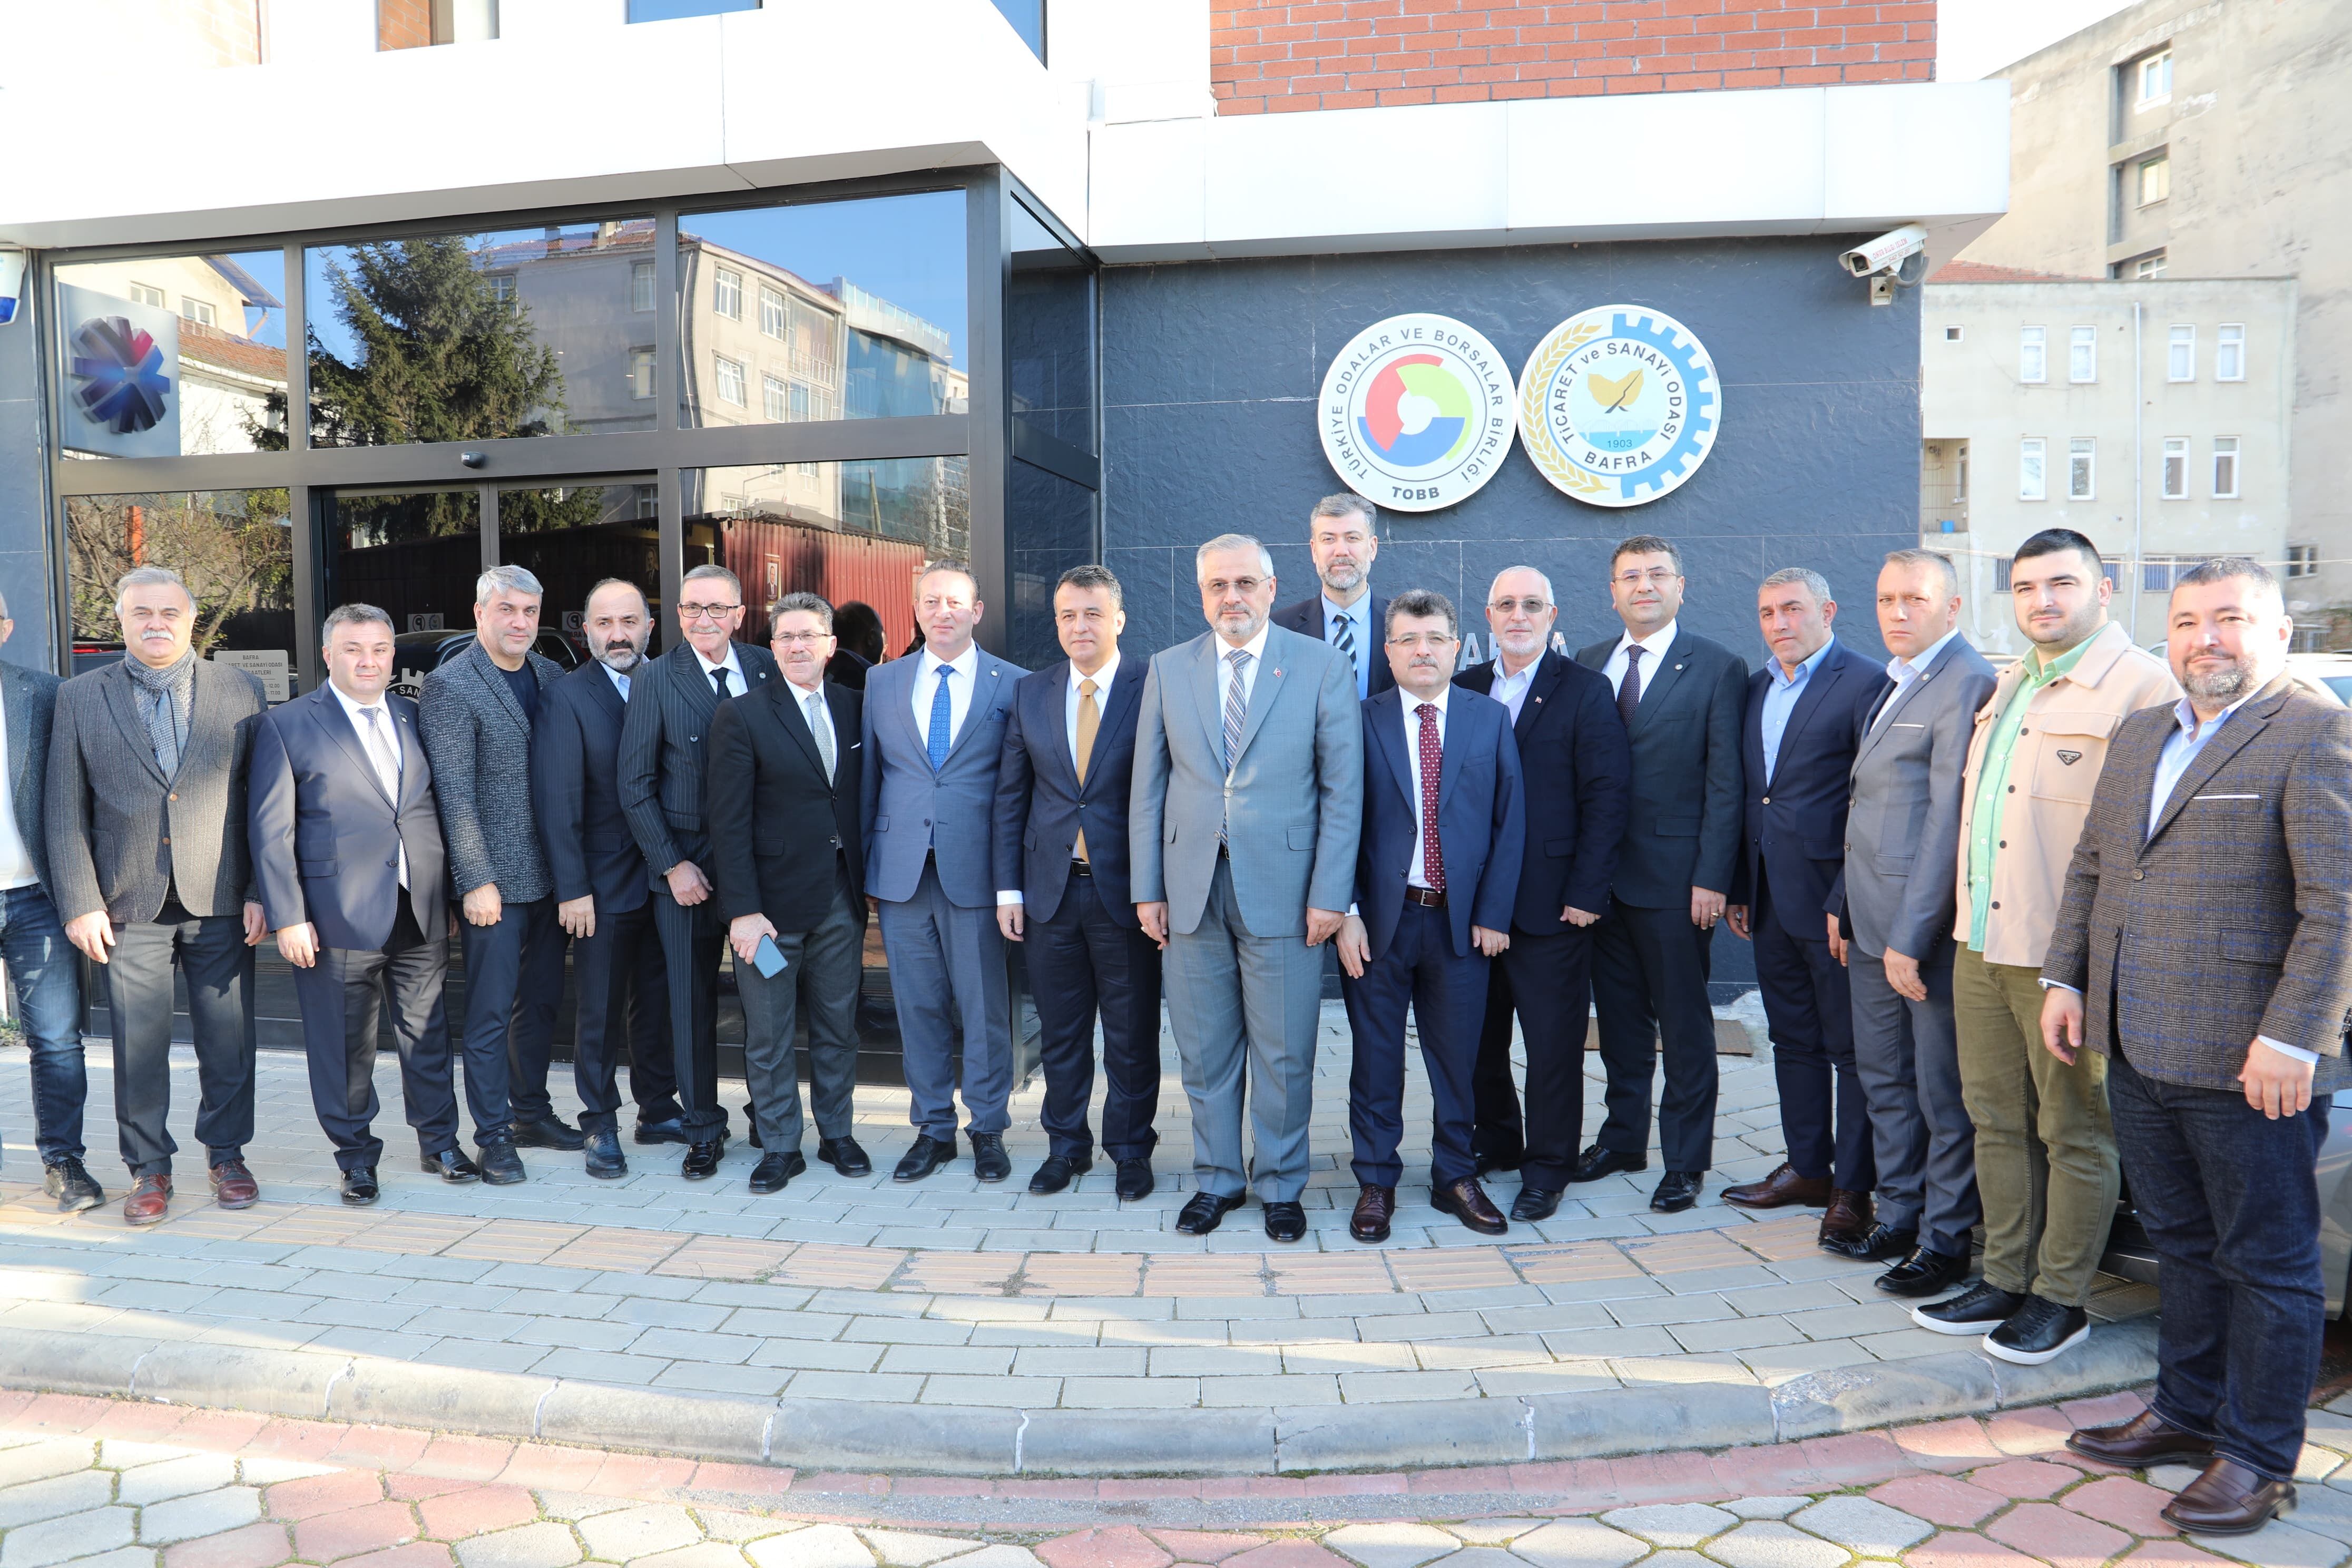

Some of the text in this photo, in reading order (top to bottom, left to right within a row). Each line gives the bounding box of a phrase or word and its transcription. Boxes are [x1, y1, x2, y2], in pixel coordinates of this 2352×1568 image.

[1581, 350, 1600, 364] ve
[1660, 381, 1681, 440] ODASI
[1331, 328, 1503, 483] TÜRKİYE ODALAR VE BORSALAR BİRLİĞİ
[1607, 439, 1632, 448] 1903
[1584, 451, 1652, 469] BAFRA
[1392, 486, 1440, 500] TOBB
